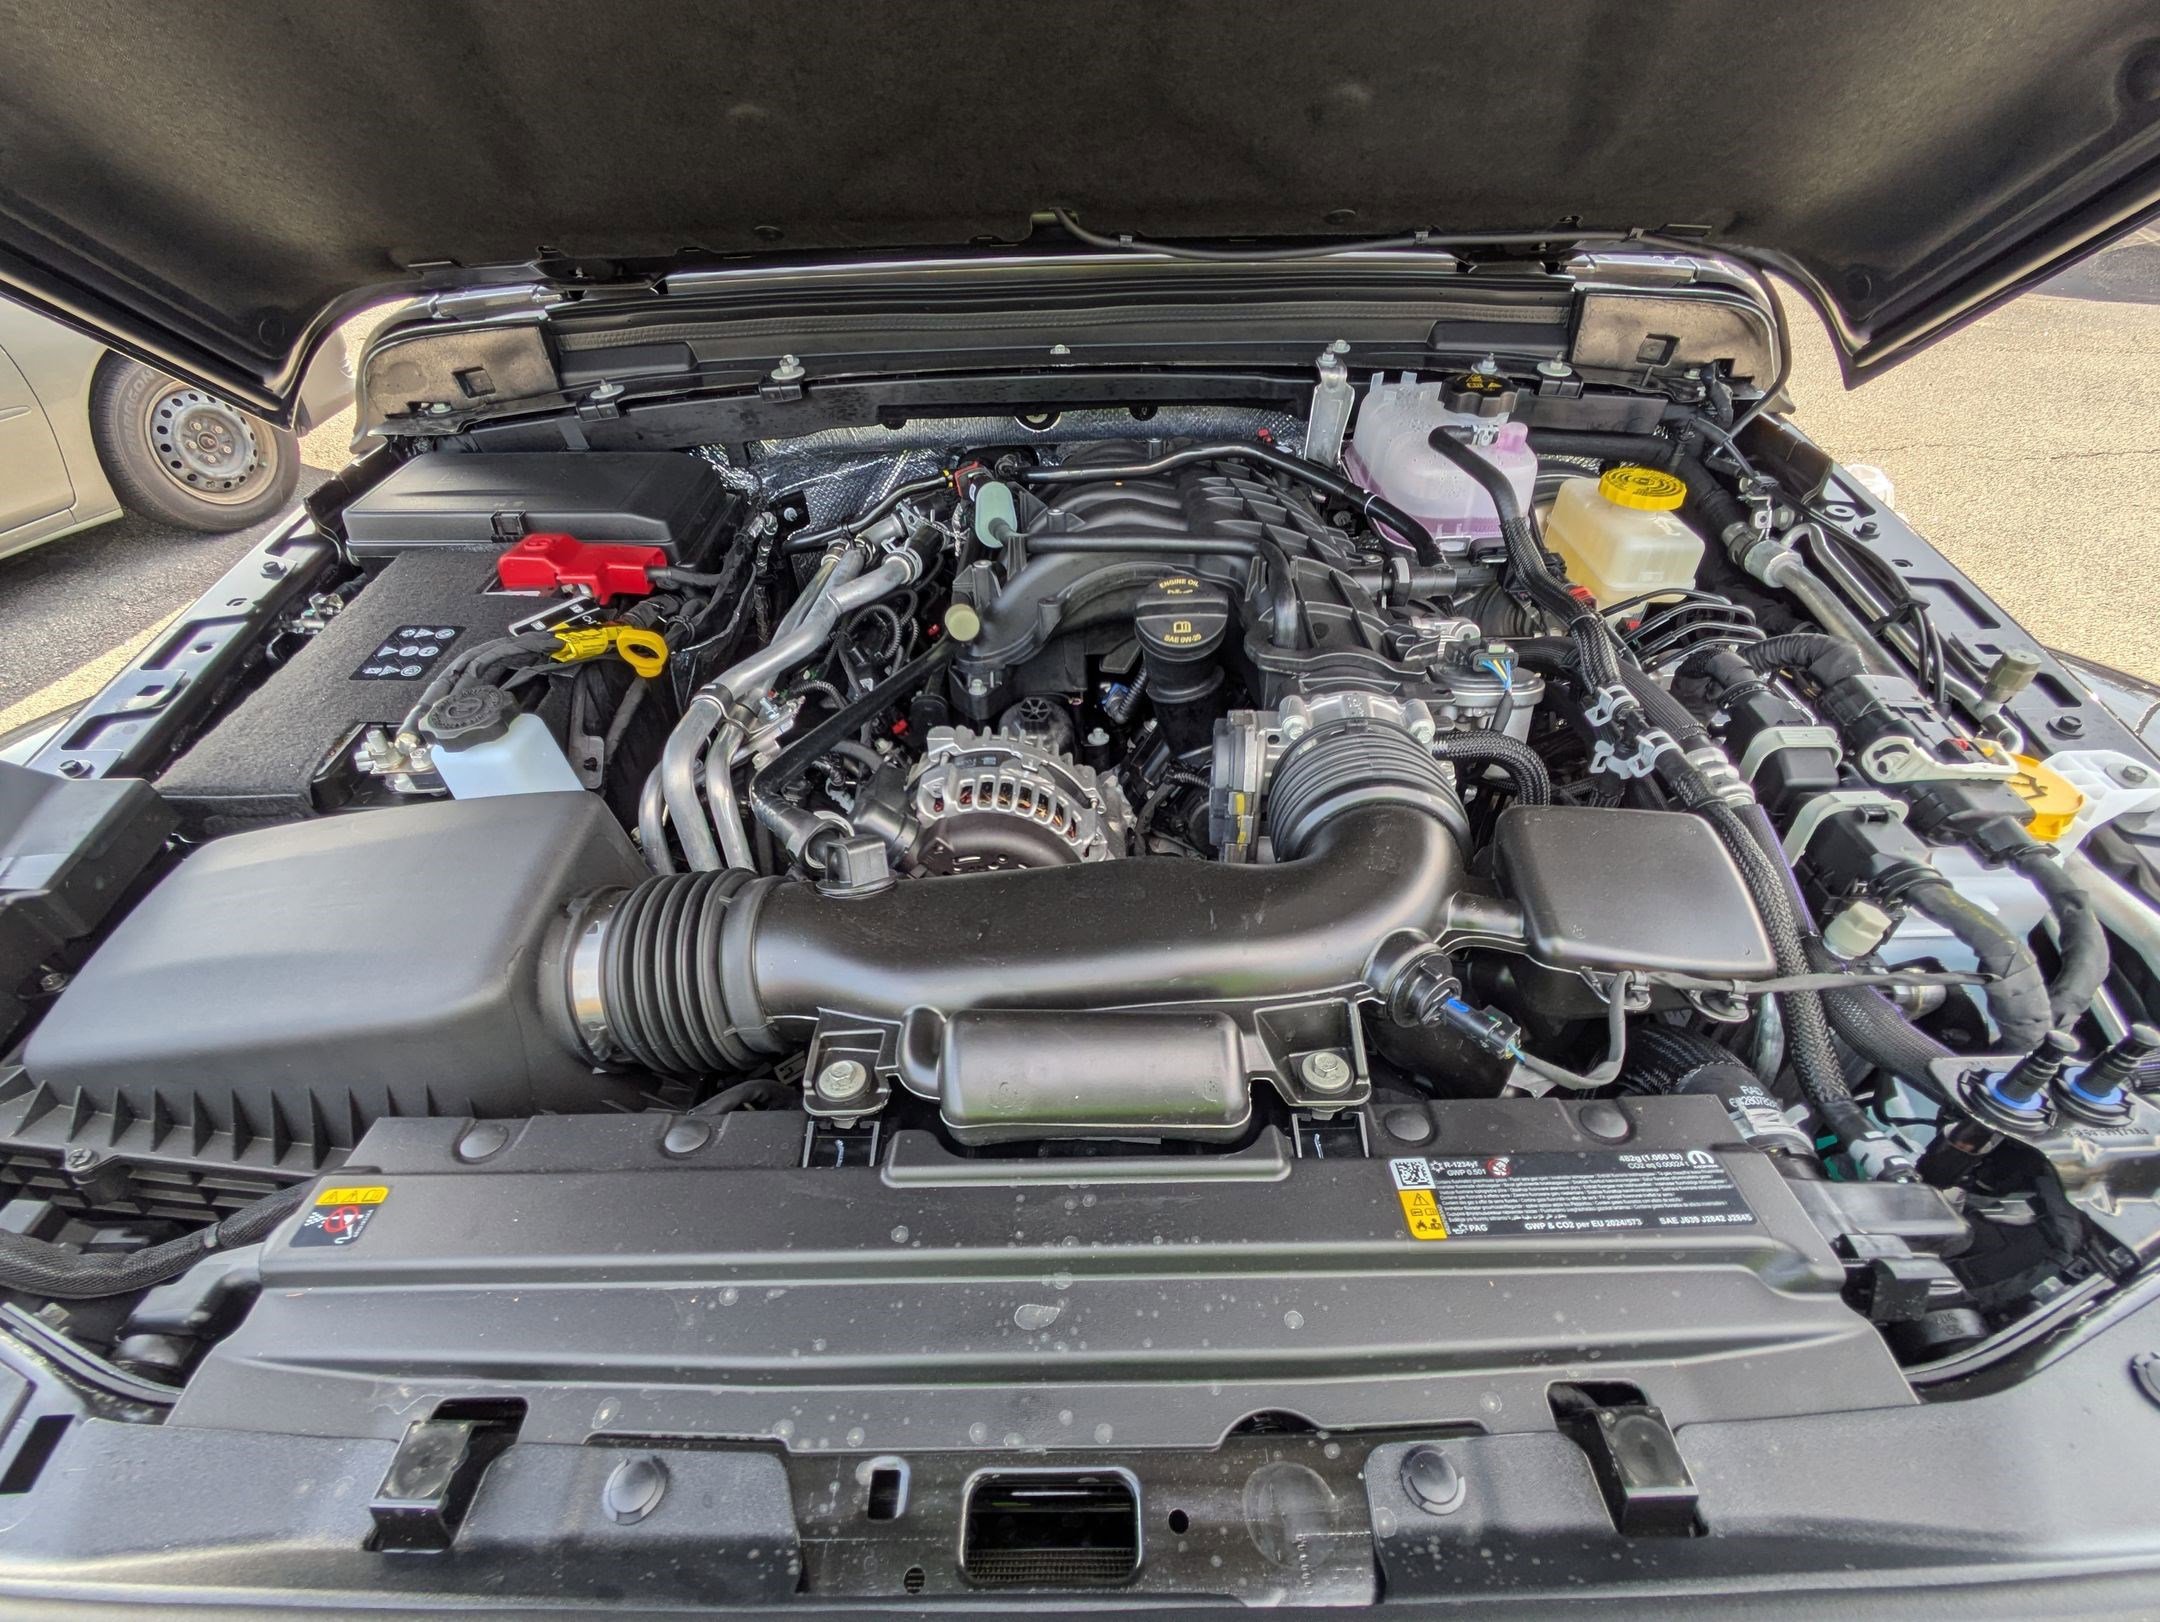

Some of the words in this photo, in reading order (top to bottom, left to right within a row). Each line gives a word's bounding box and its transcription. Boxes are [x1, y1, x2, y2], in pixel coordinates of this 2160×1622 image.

[123, 368, 156, 457] PARAGON
[1159, 578, 1187, 589] ENGINE
[1188, 579, 1199, 588] OIL
[1164, 634, 1180, 644] SAE
[1740, 1085, 1764, 1096] RAD
[1443, 1160, 1478, 1169] R-1234yf
[1446, 1168, 1466, 1177] GWP
[1466, 1168, 1486, 1176] 0.501
[1524, 1222, 1546, 1230] GWP
[1547, 1222, 1555, 1230] &
[1556, 1221, 1575, 1229] CO2
[1576, 1222, 1590, 1231] per
[1591, 1219, 1604, 1227] EU
[1606, 1218, 1643, 1227] 2024/573
[1658, 1216, 1679, 1225] SAE
[1469, 1224, 1488, 1232] PAG
